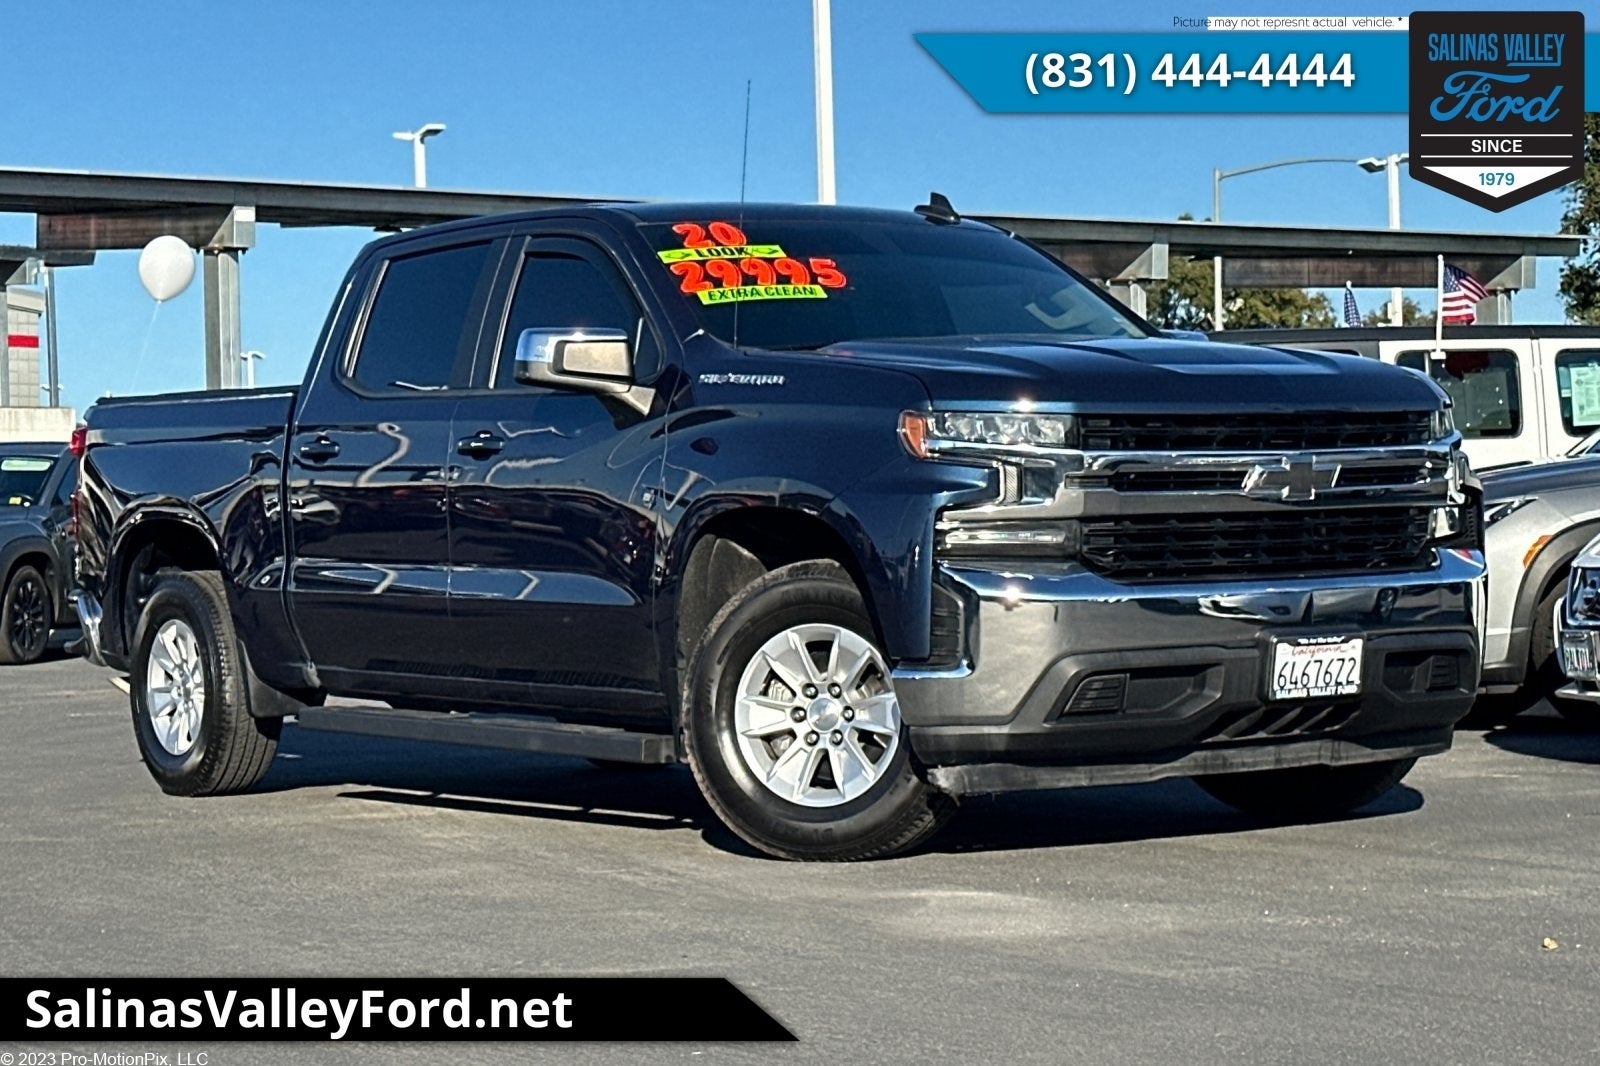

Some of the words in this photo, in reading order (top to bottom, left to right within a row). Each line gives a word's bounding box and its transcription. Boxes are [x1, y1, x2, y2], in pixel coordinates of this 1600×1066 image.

[672, 221, 747, 247] 20
[694, 246, 754, 258] LOOK
[670, 257, 847, 293] 29995
[707, 286, 762, 301] EXTRA
[764, 285, 815, 298] CLEAN
